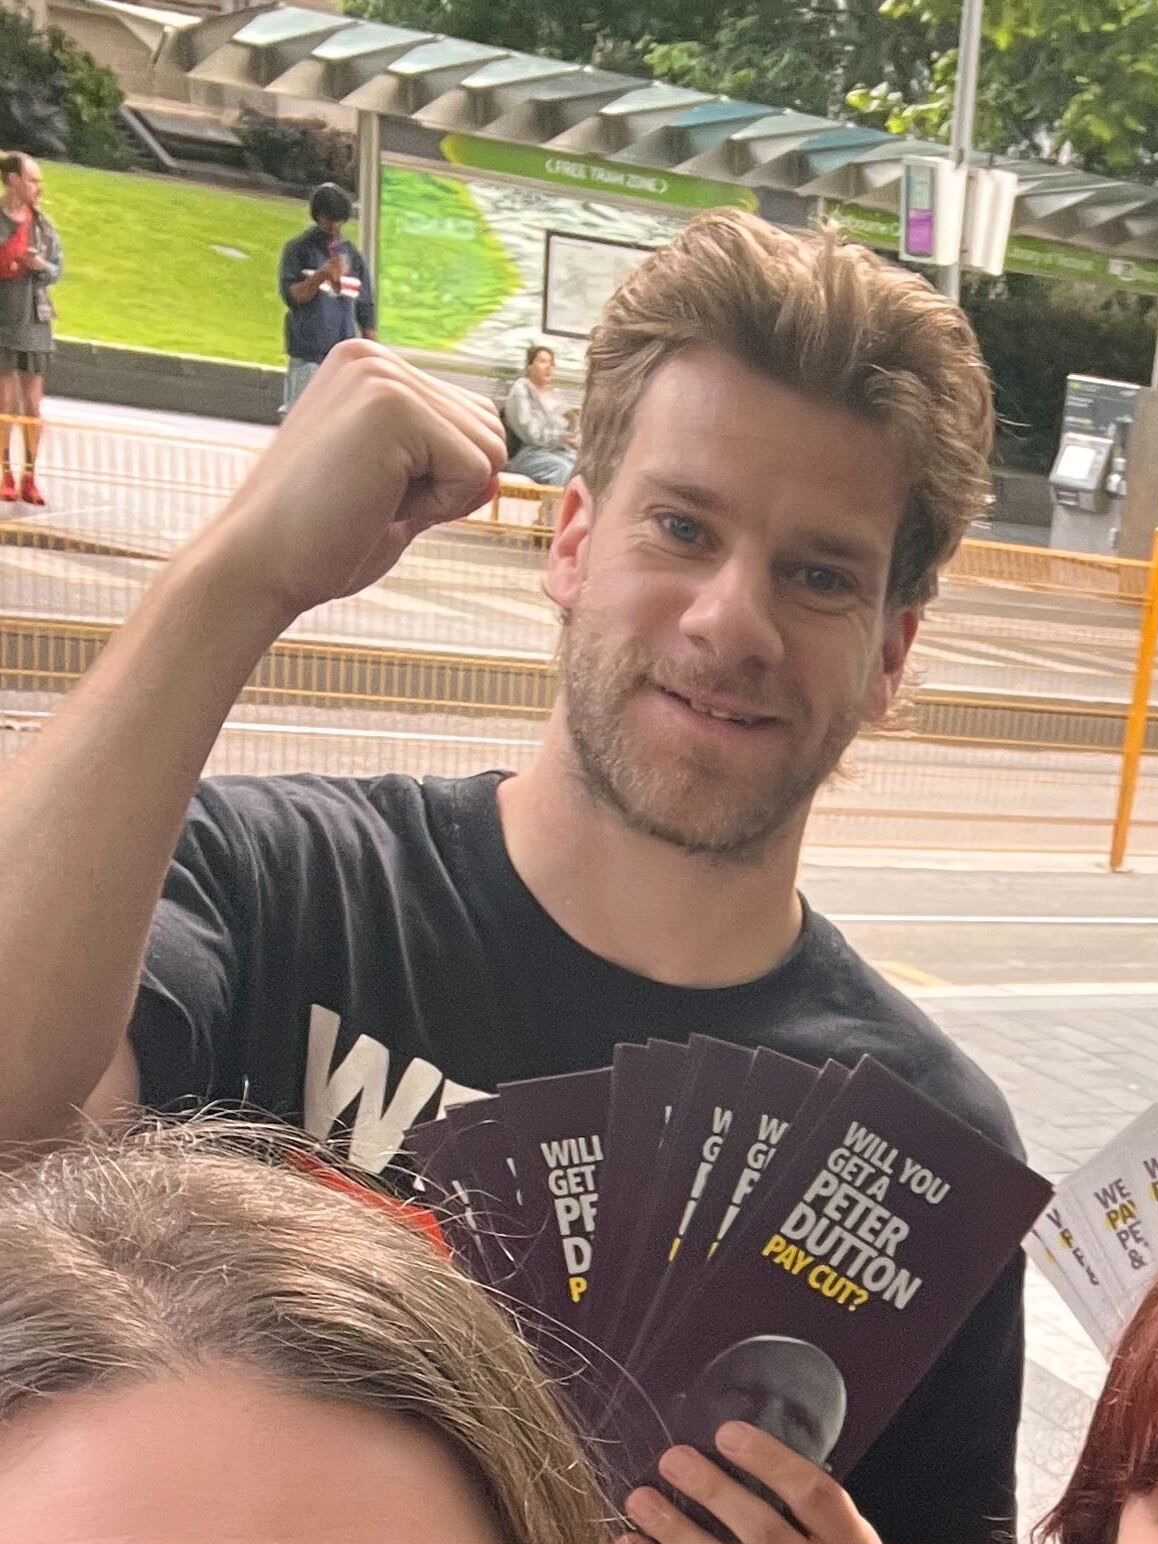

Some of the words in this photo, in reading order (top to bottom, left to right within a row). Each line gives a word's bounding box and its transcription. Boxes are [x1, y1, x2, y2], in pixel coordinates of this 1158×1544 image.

[548, 1164, 596, 1196] GET
[827, 1147, 875, 1187] GET
[866, 1175, 890, 1202] A
[843, 1121, 899, 1175] WILL
[899, 1157, 951, 1204] YOU
[803, 1169, 911, 1257] PETER
[1094, 1178, 1131, 1209] WE
[1105, 1200, 1137, 1230] PA
[761, 1234, 815, 1275] PAY
[807, 1264, 869, 1311] CUT?
[780, 1201, 922, 1310] DUTTON
[1128, 1249, 1147, 1270] &
